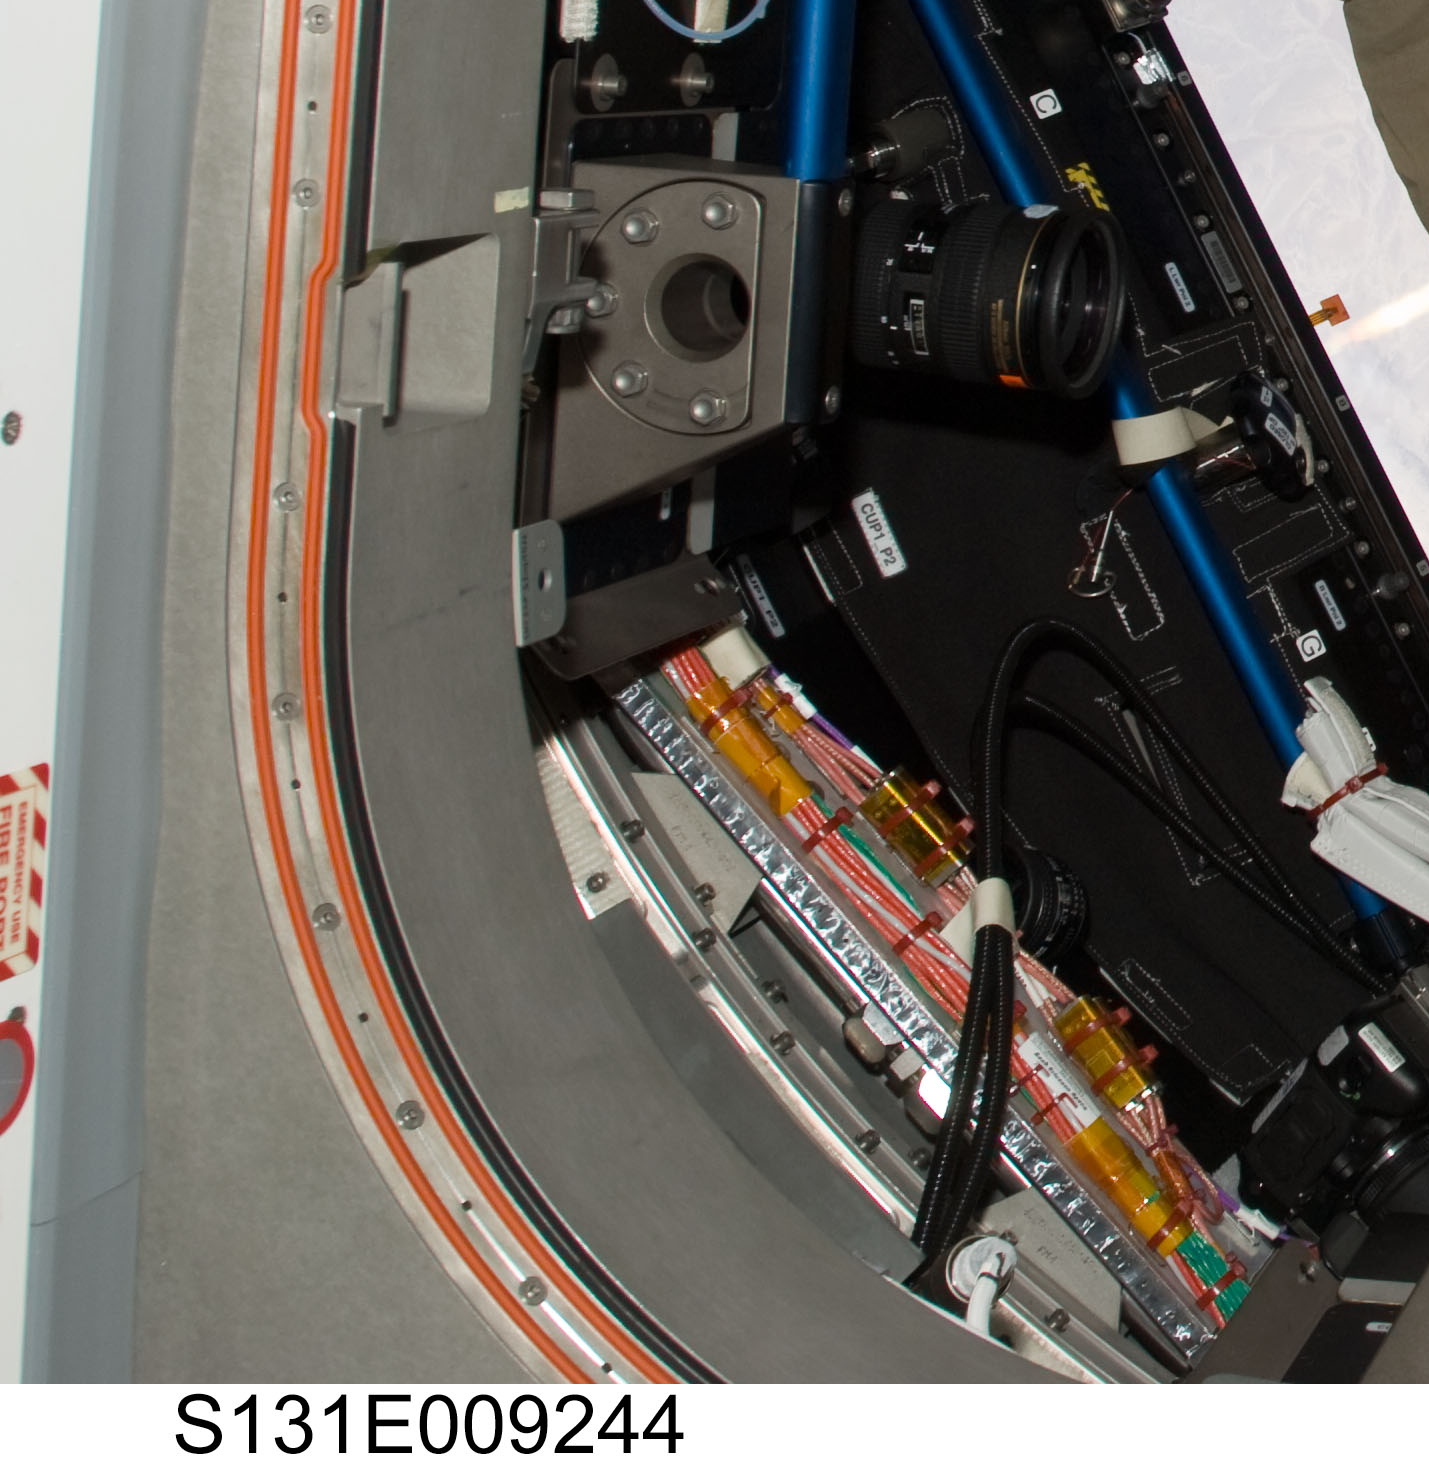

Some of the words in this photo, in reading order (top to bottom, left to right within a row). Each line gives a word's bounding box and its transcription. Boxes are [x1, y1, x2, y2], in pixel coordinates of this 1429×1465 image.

[1036, 94, 1057, 113] C
[861, 503, 896, 566] CUP1_P2
[1301, 636, 1322, 658] G
[13, 800, 28, 905] EMERGENCY
[11, 909, 21, 945] USE
